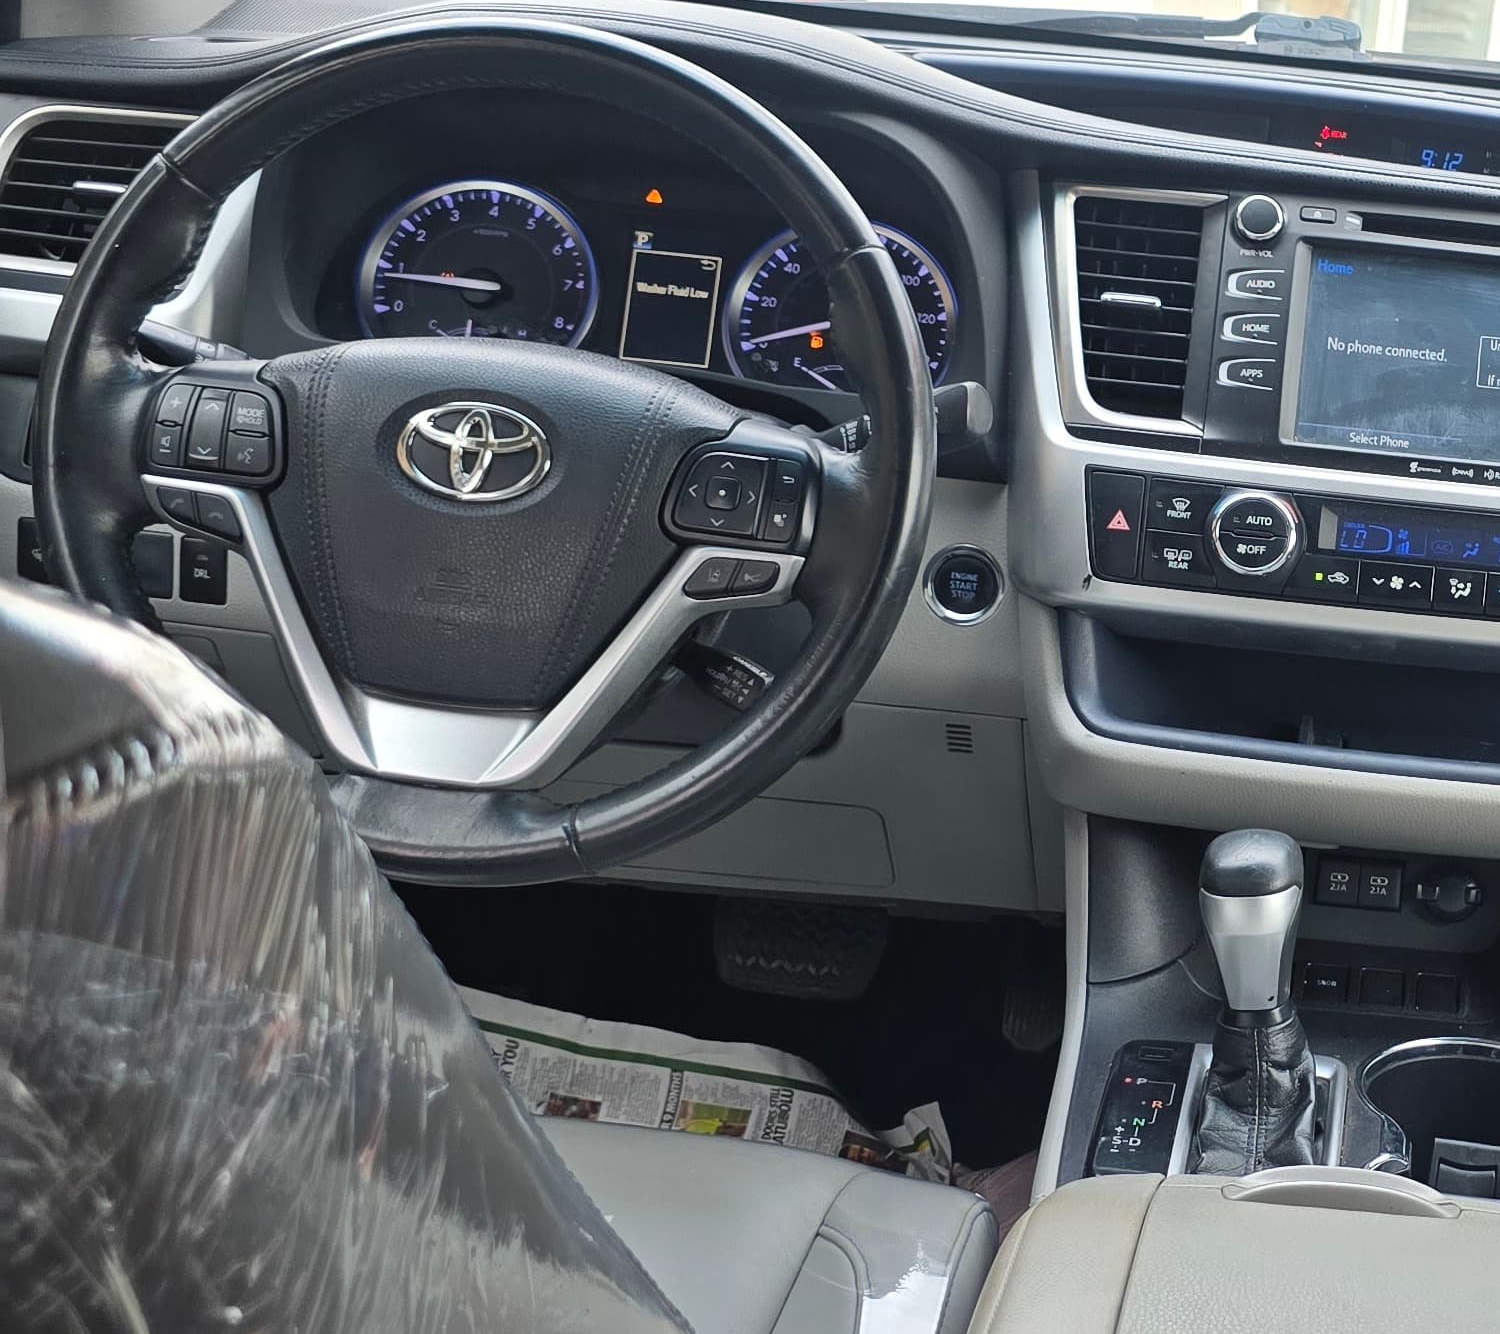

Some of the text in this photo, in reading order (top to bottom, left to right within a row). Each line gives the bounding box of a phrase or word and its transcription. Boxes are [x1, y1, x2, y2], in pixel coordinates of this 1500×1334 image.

[1422, 149, 1463, 171] 9:12
[450, 210, 460, 222] 3
[488, 206, 499, 217] 4
[526, 218, 536, 230] 5
[416, 229, 427, 242] 2
[552, 244, 562, 256] 6
[783, 262, 801, 274] 40
[1318, 258, 1354, 275] Home
[563, 279, 573, 291] 7
[1246, 279, 1276, 289] AUDIO
[689, 287, 709, 299] Low
[393, 300, 404, 312] 0
[761, 296, 777, 308] 20
[554, 317, 564, 329] 8
[917, 313, 936, 324] 120
[428, 319, 438, 330] C
[1242, 323, 1270, 333] HOME
[1327, 336, 1447, 362] No phone connected.
[793, 358, 802, 367] E
[1240, 368, 1264, 378] APPS
[1487, 374, 1495, 386] If
[1349, 432, 1410, 449] Select Phone
[1166, 509, 1192, 519] FRONT
[1246, 515, 1273, 526] AUTO
[1247, 544, 1267, 555] OFF
[1168, 560, 1189, 570] REAR
[950, 572, 978, 581] ENGINE
[950, 580, 978, 590] START
[951, 590, 976, 598] STOP
[501, 1038, 520, 1066] YOU
[1136, 1077, 1148, 1085] P
[666, 1071, 682, 1113] MONTHS
[1152, 1100, 1163, 1109] R
[1132, 1117, 1145, 1126] N
